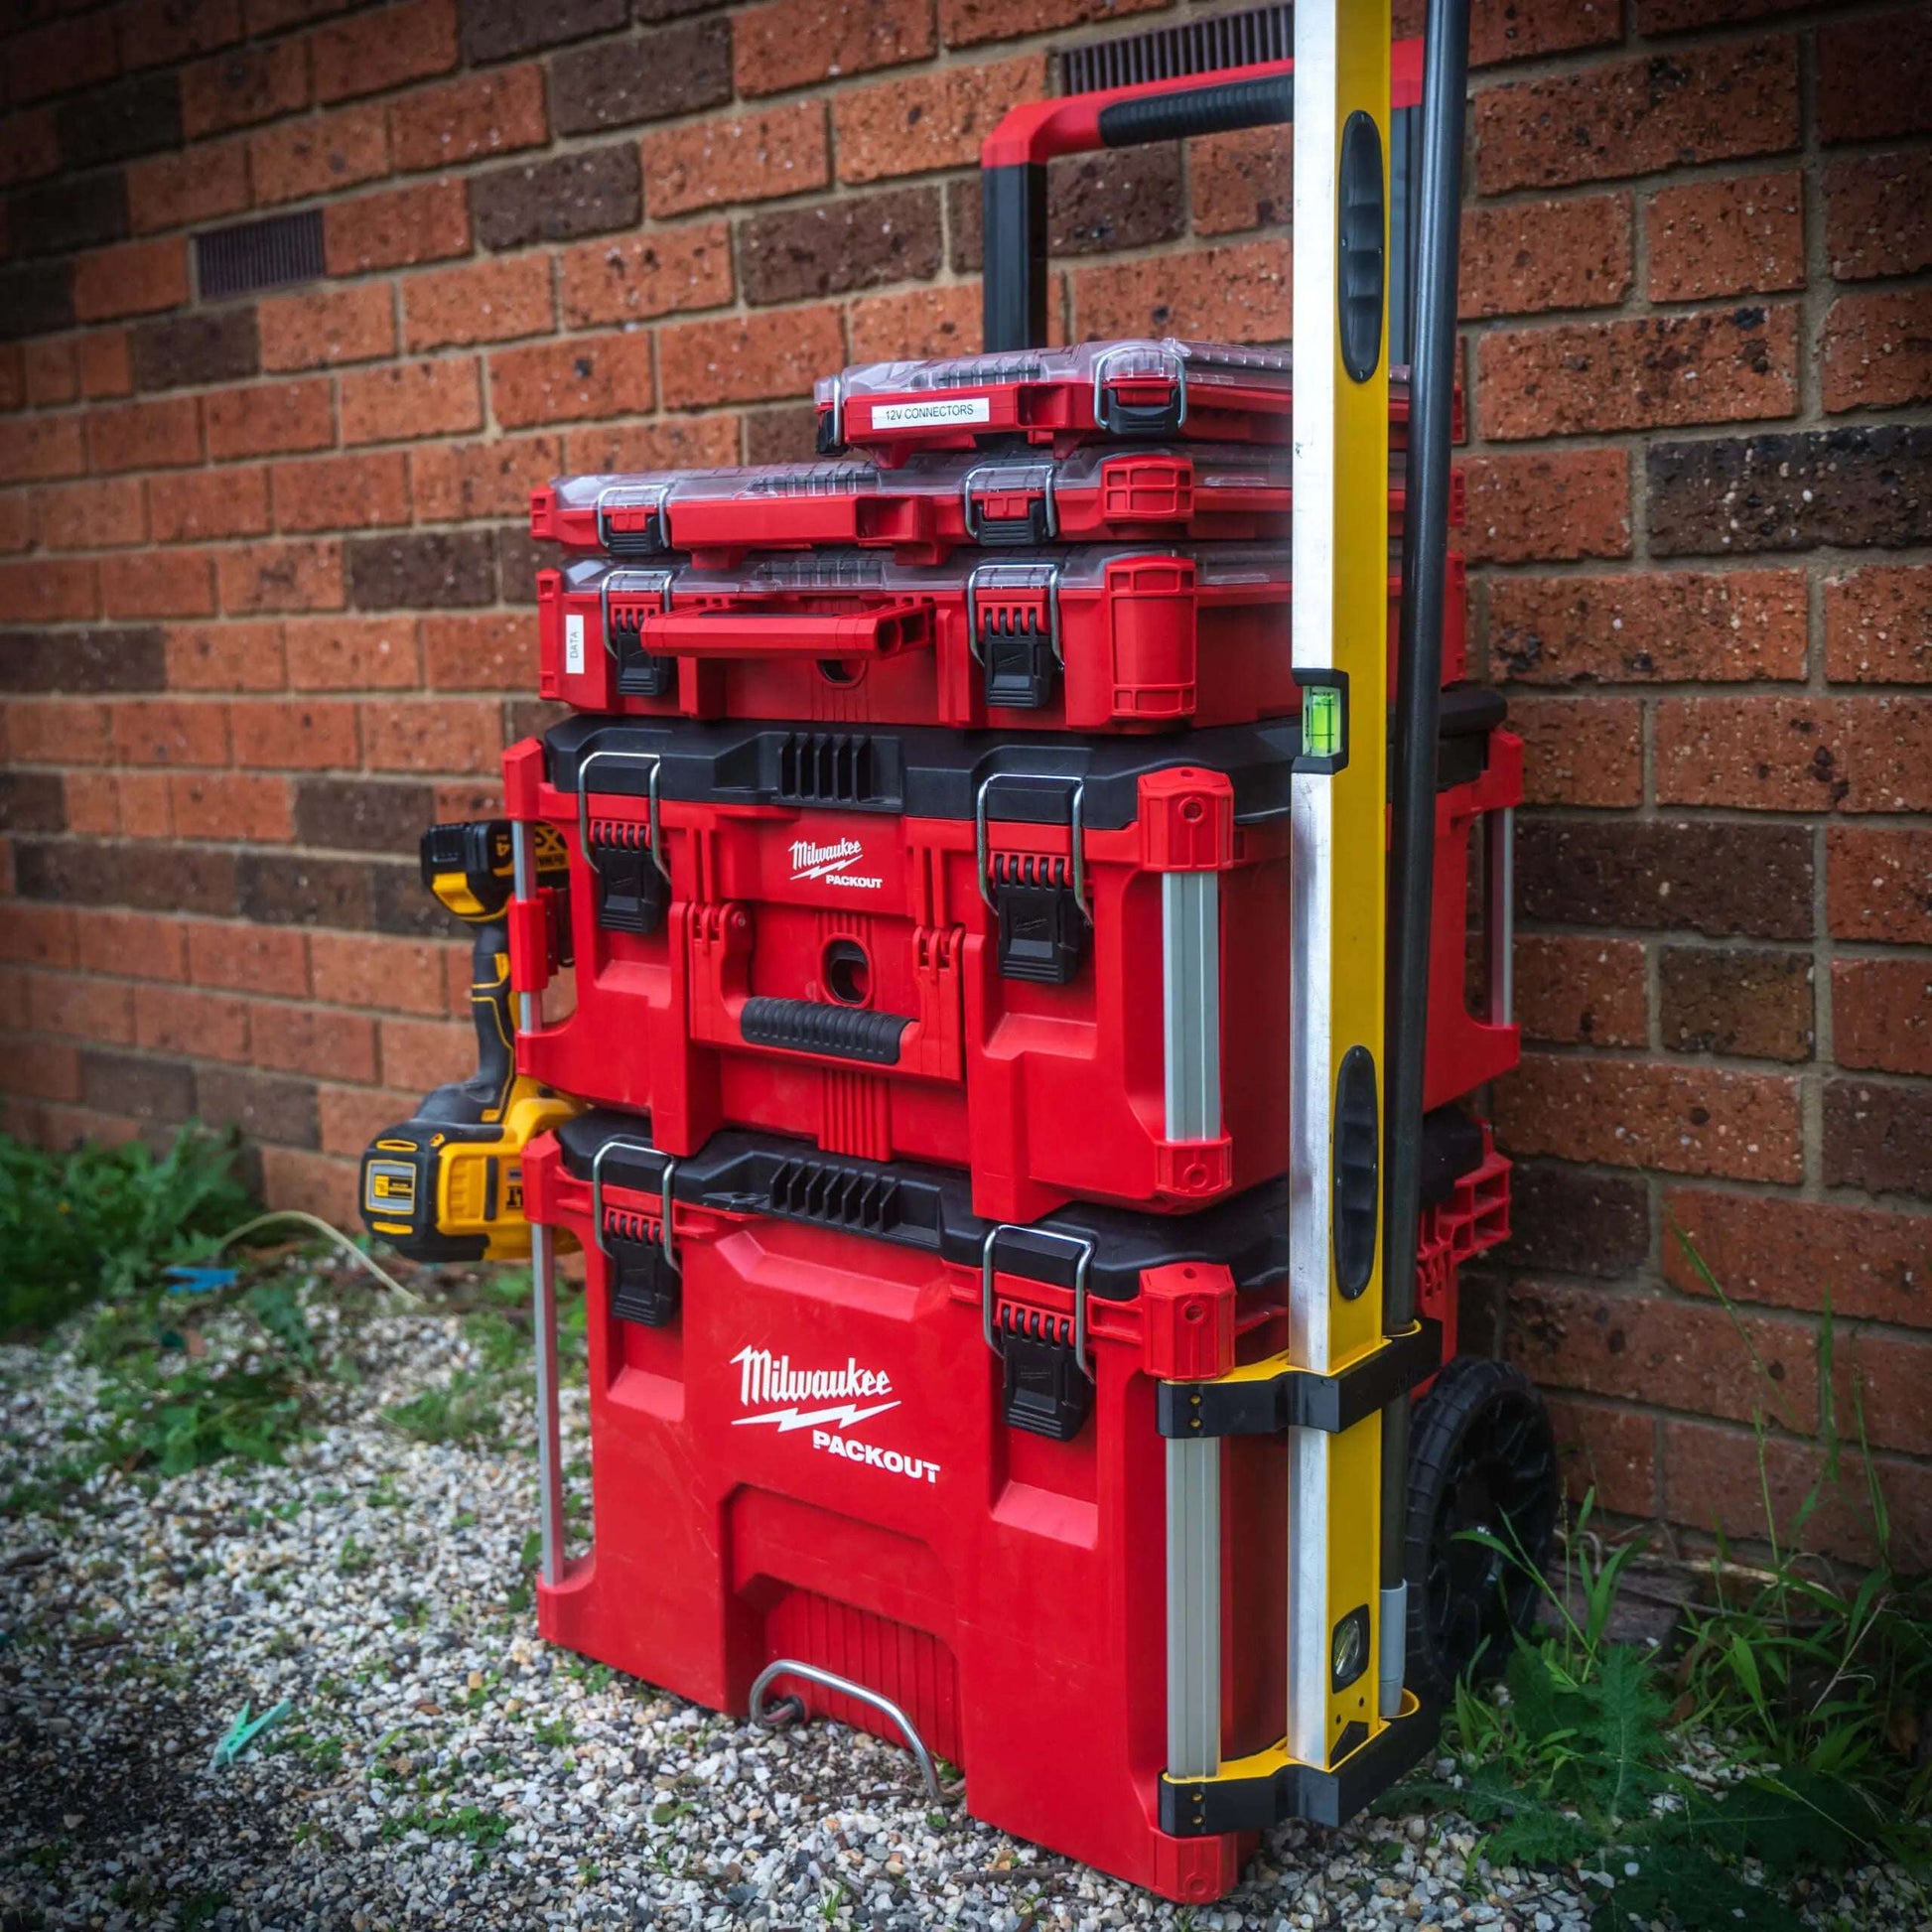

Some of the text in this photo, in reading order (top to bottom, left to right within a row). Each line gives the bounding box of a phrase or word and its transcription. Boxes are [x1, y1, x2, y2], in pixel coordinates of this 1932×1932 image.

[885, 404, 974, 421] 12V CONNECTORS
[569, 630, 579, 659] DATA
[787, 837, 863, 871] Milwaukee
[825, 874, 884, 889] PACKOUT
[730, 1344, 894, 1407] Milwaukee
[812, 1430, 941, 1483] PACKOUT
